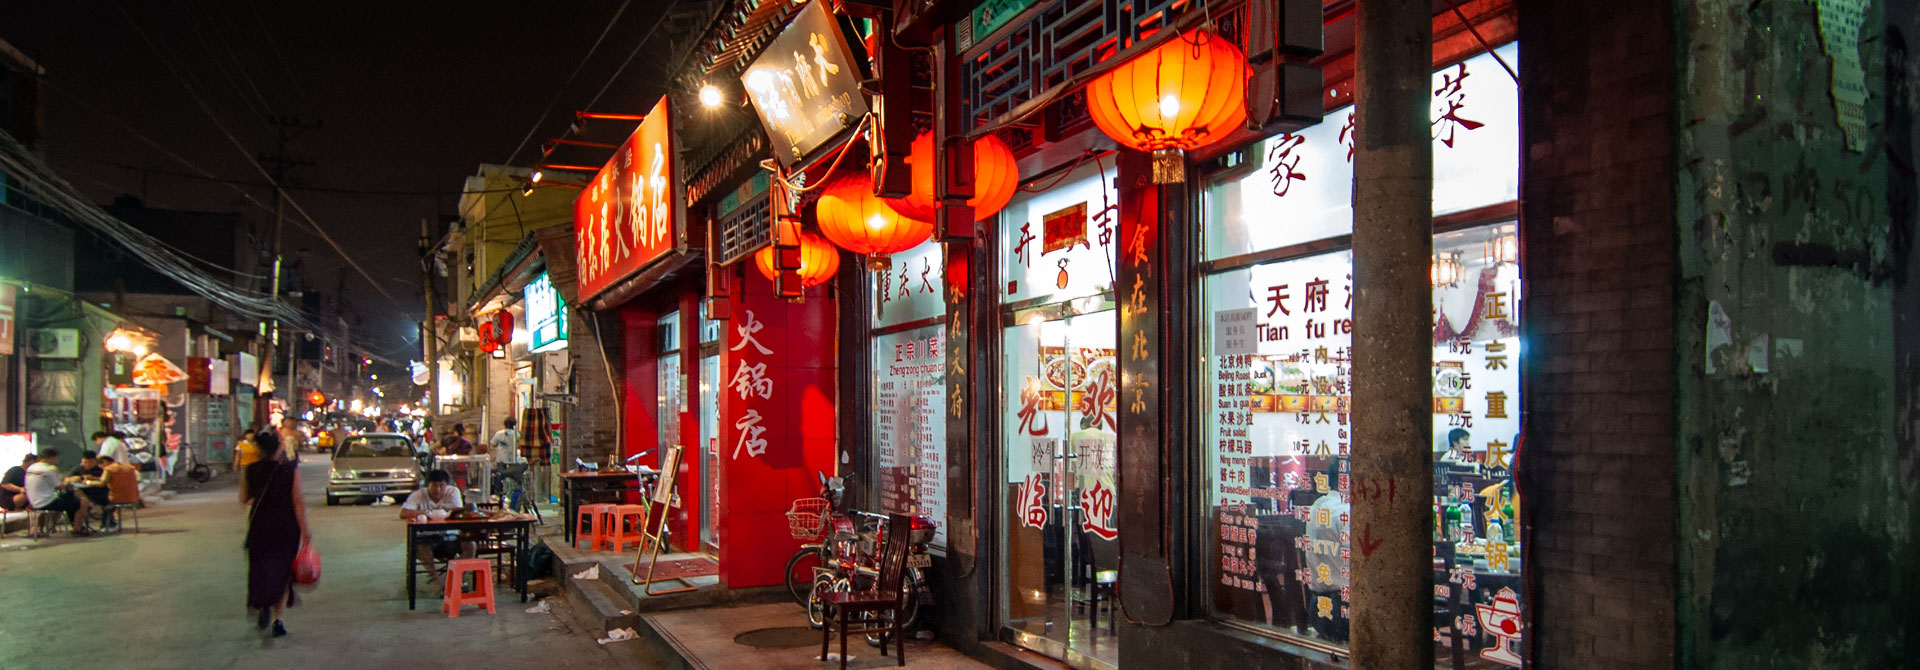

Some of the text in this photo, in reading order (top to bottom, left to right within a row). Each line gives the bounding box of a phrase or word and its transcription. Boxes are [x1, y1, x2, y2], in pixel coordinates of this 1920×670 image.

[1256, 322, 1289, 342] Tian
[1305, 318, 1325, 339] fu
[895, 337, 938, 362] 正宗川菜
[1448, 337, 1472, 355] 18元
[727, 309, 775, 461] 火锅店
[1447, 372, 1472, 390] 16元
[1219, 410, 1254, 425] 水果沙拉
[1448, 411, 1473, 428] 22元
[1484, 291, 1510, 573] 正宗重庆火锅
[1292, 439, 1311, 455] 10元
